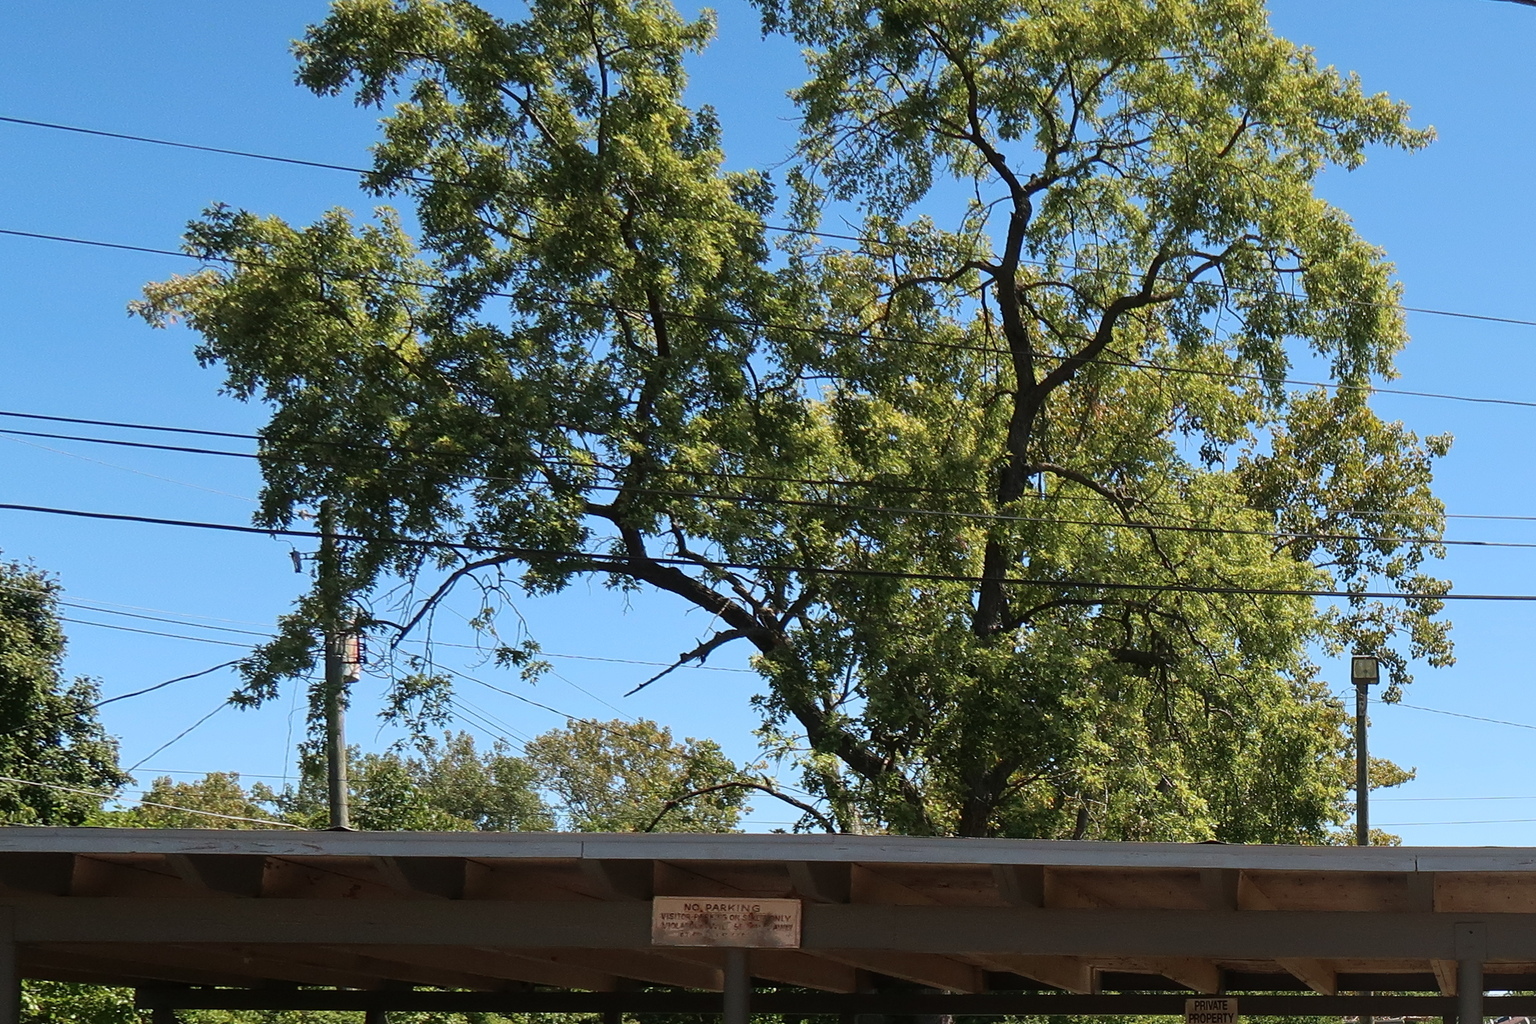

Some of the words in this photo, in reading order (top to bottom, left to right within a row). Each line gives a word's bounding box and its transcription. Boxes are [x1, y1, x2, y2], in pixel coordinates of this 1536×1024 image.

[706, 904, 761, 912] PARKING
[660, 912, 690, 920] VISITOR
[1194, 1000, 1228, 1011] PRIVATE
[1188, 1013, 1234, 1024] PROPERTY
